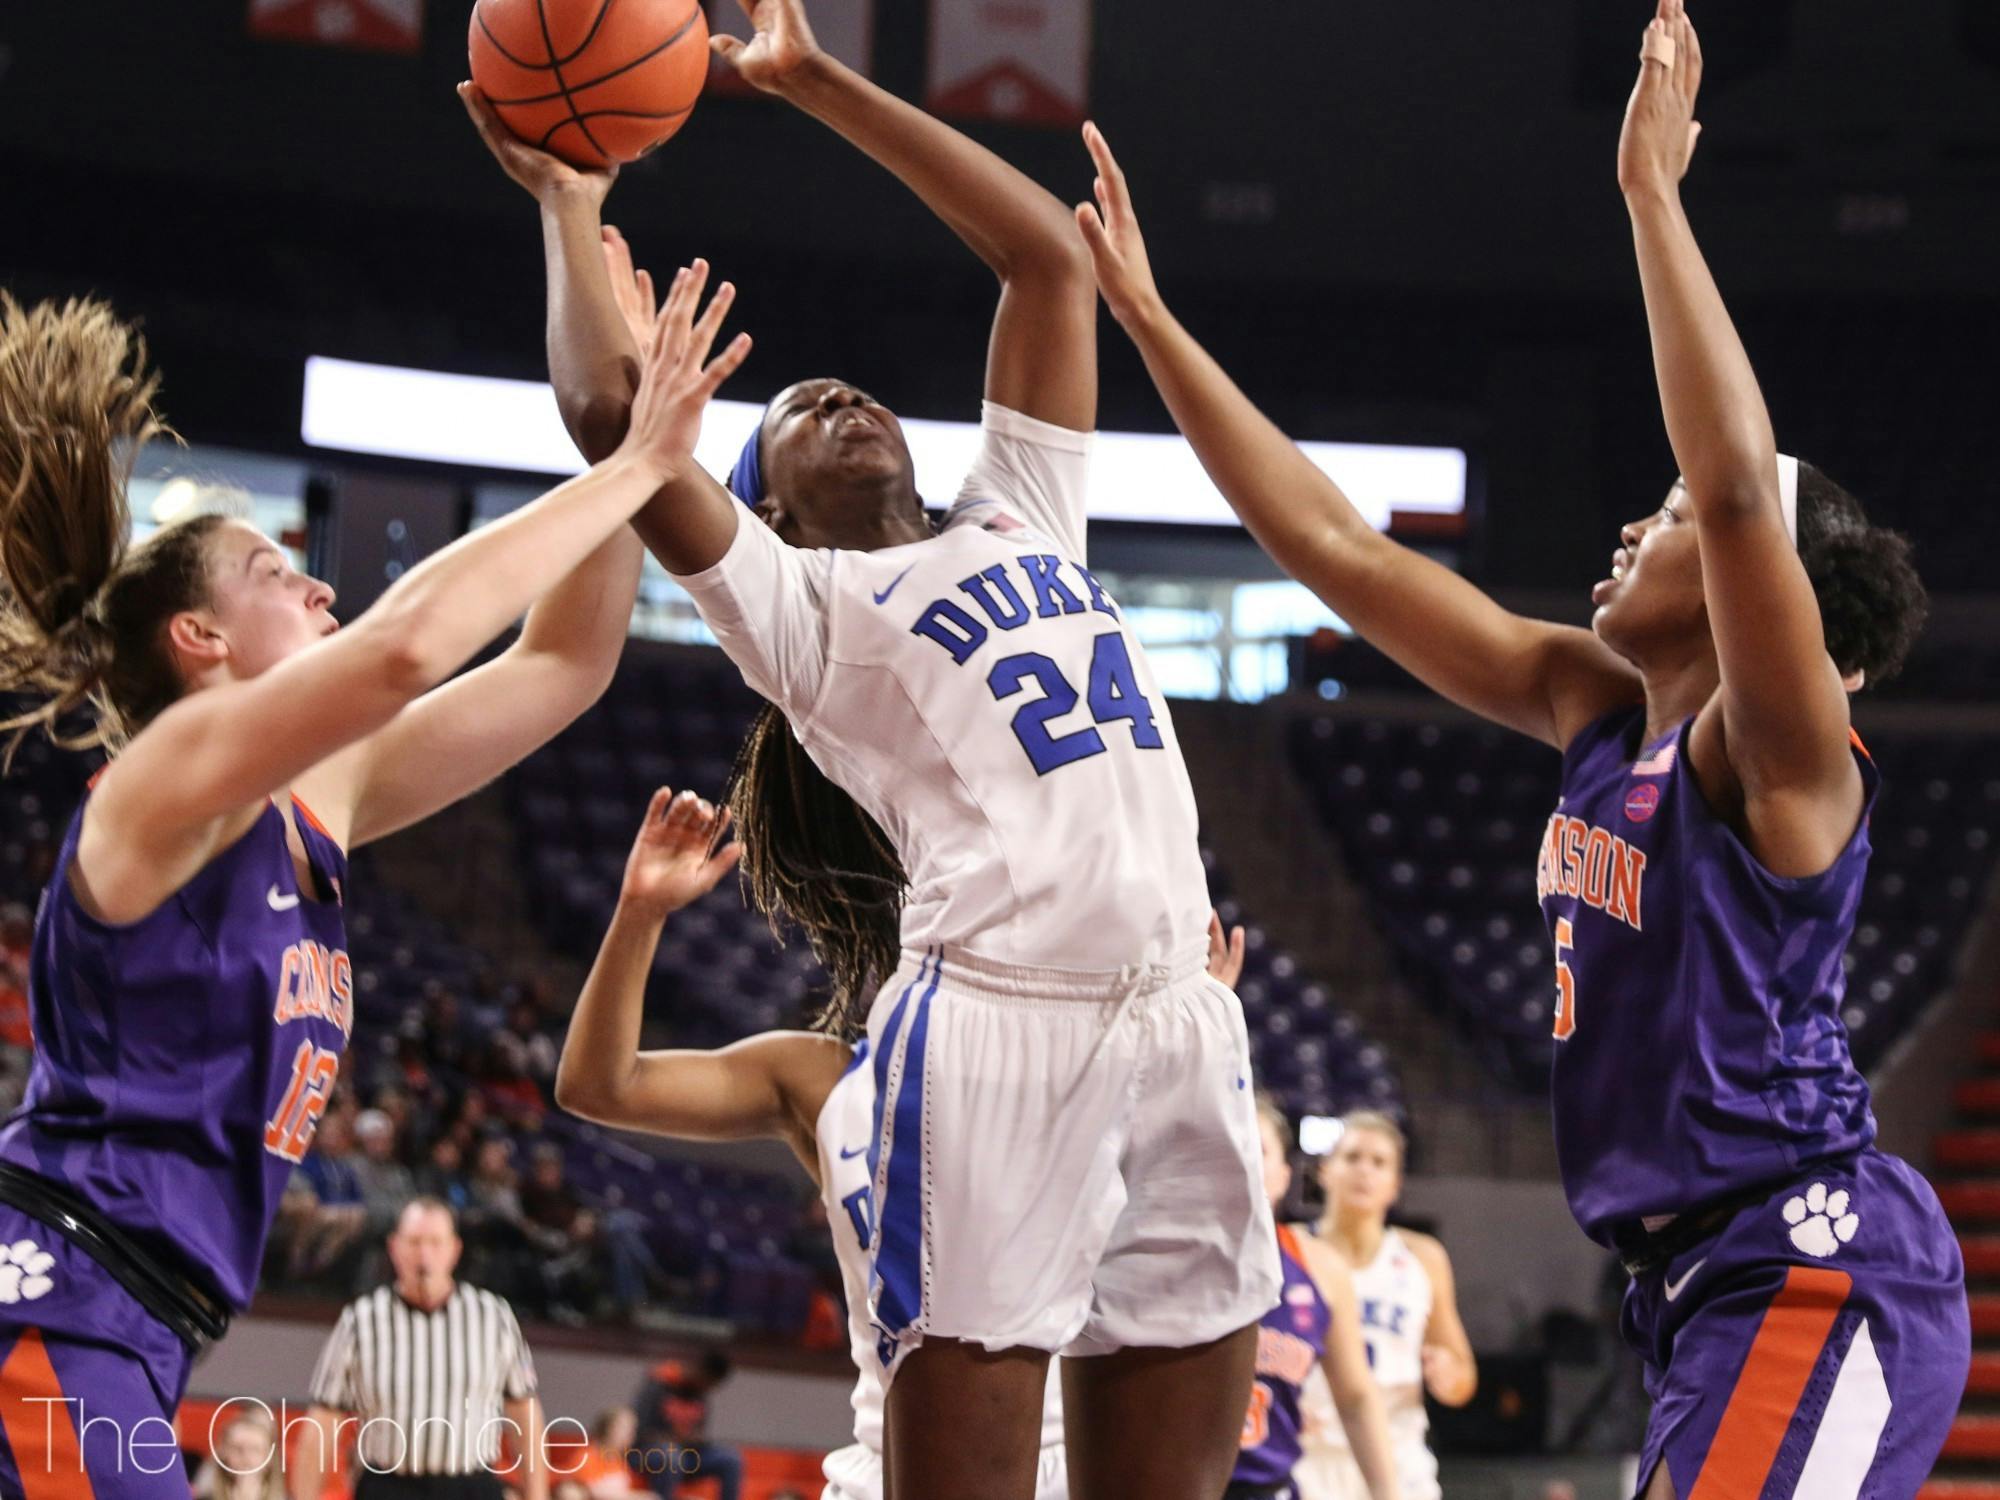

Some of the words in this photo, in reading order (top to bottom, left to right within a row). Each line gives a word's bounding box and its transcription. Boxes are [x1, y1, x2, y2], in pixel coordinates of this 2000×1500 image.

[911, 554, 1120, 666] DUKE
[986, 631, 1165, 776] 24
[1552, 916, 1577, 1041] 5
[264, 1038, 339, 1164] 12
